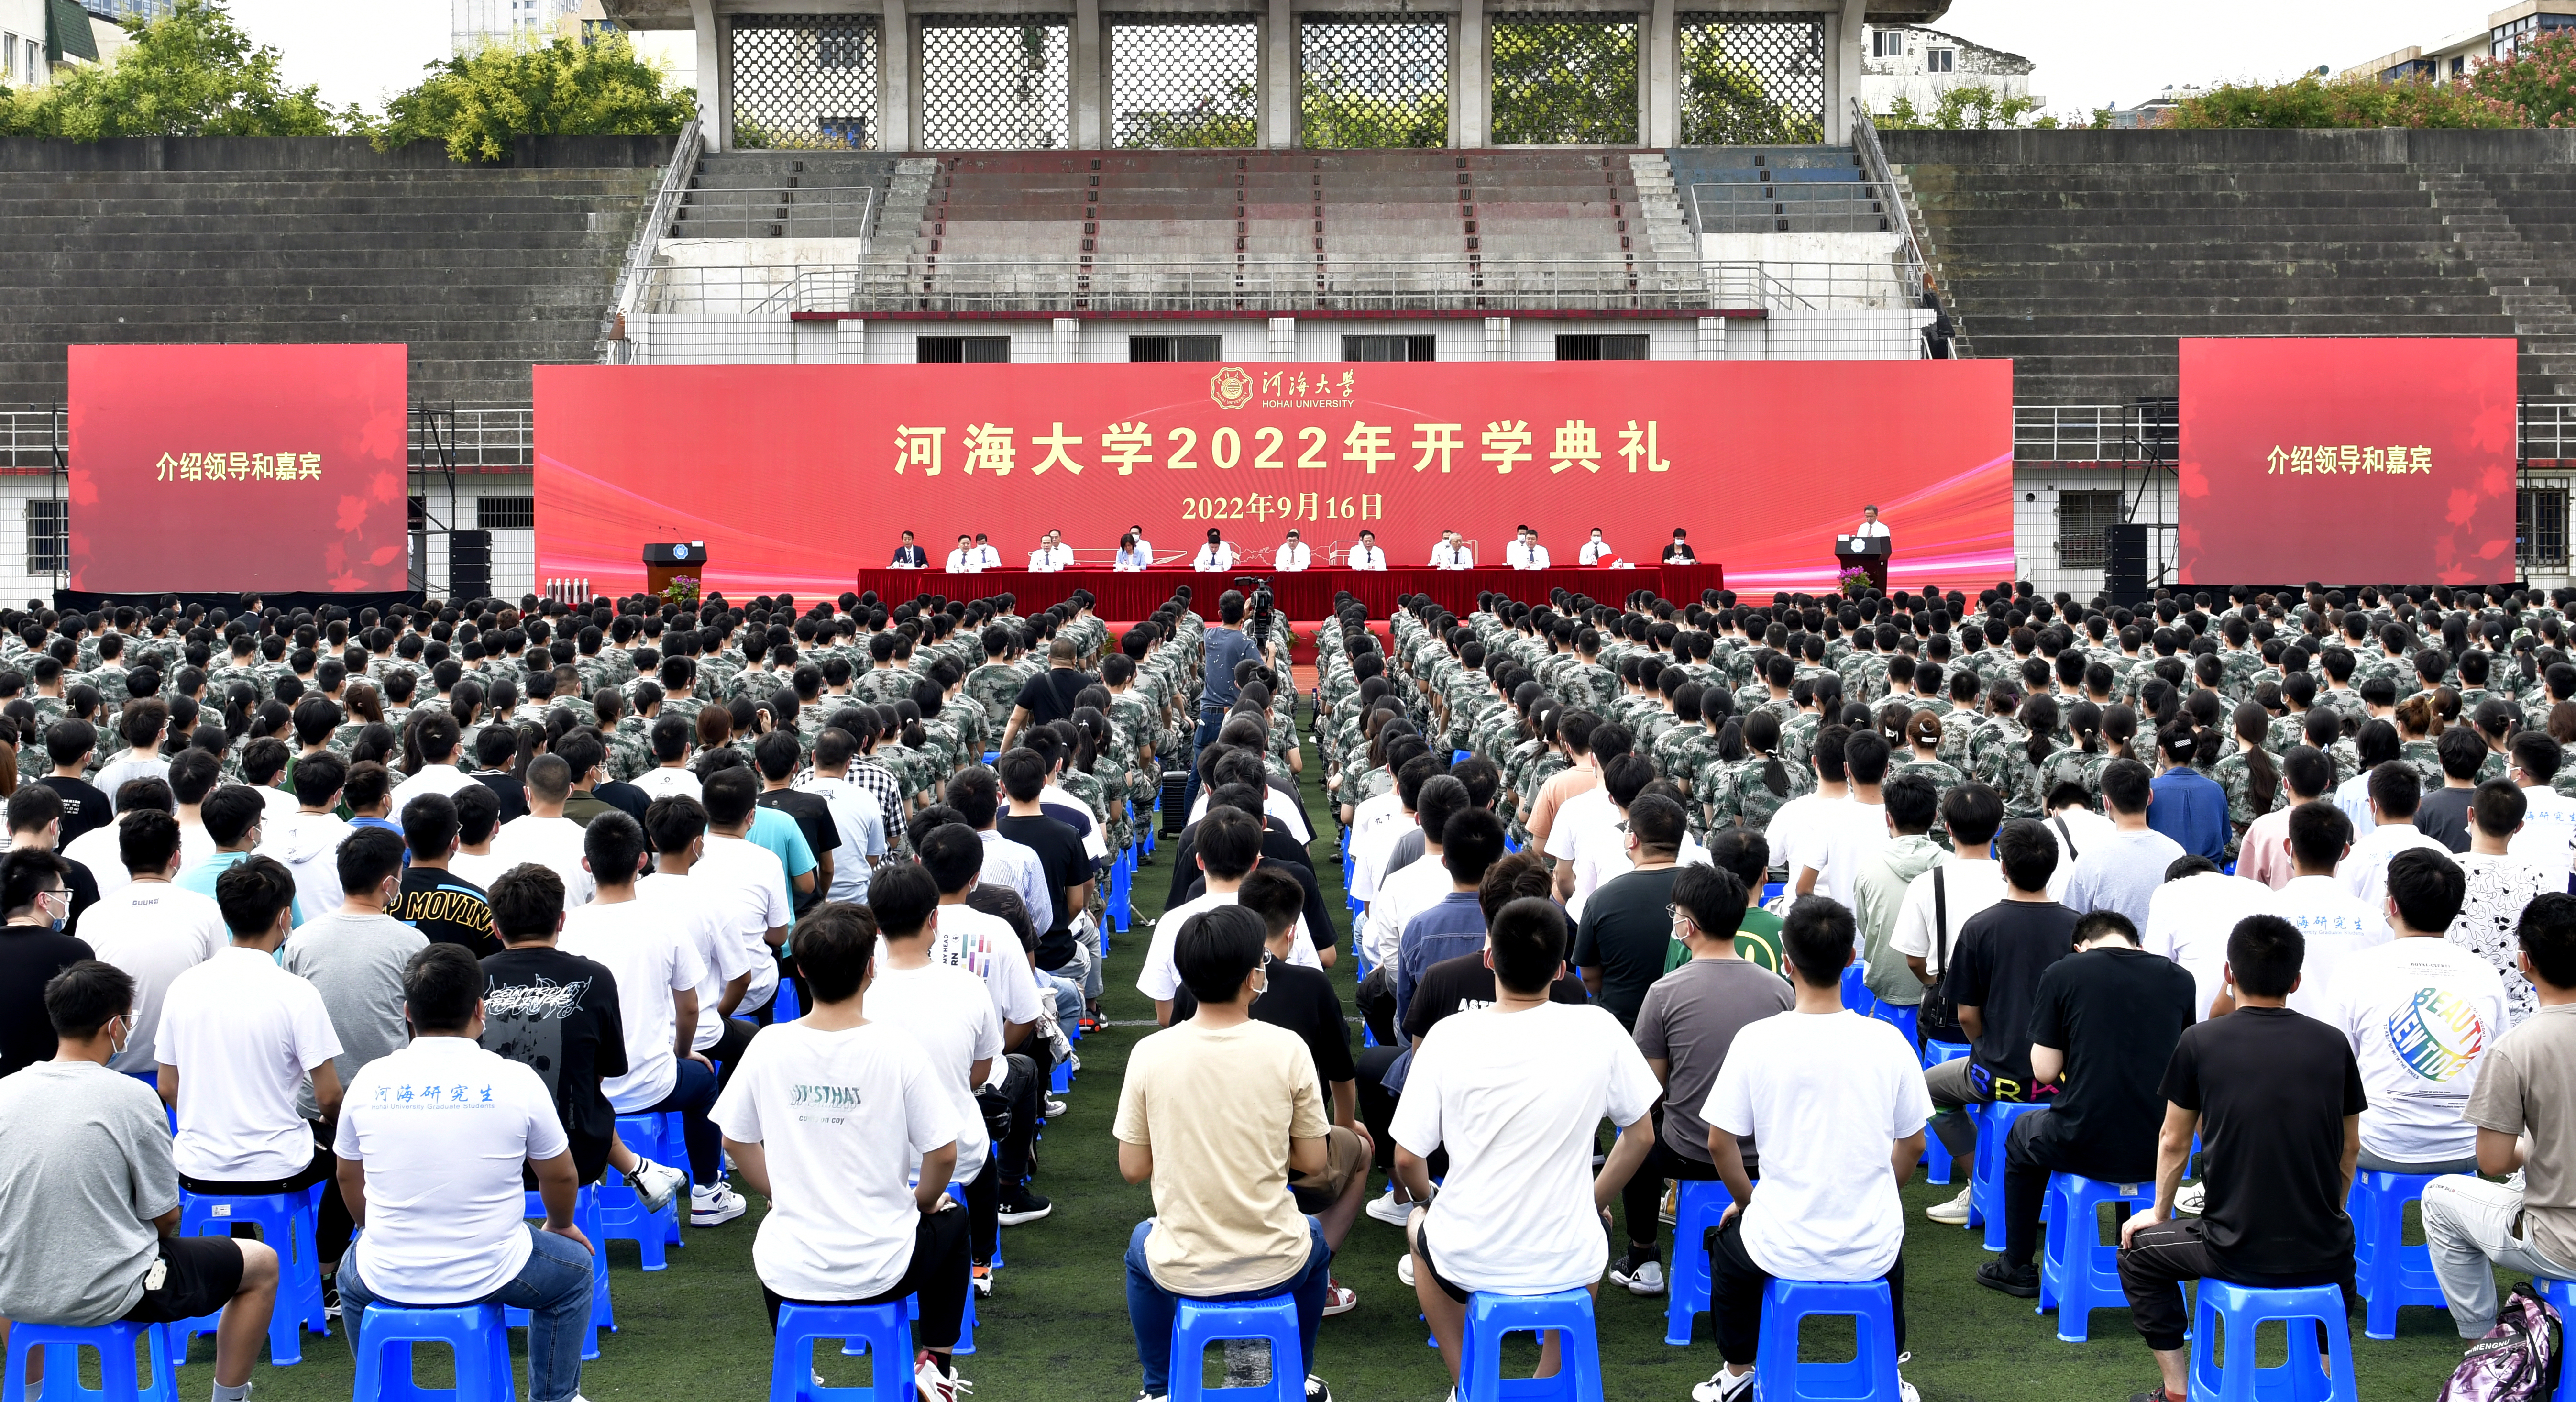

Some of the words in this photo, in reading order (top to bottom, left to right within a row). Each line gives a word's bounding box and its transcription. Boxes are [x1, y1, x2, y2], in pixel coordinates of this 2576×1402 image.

[1262, 368, 1354, 397] 河海大学
[1262, 400, 1292, 408] HOHAI
[1296, 400, 1354, 408] UNIVERSITY
[893, 421, 1671, 476] 河海大学2022年开学典礼
[2267, 444, 2432, 475] 介绍领导和嘉宾
[156, 451, 322, 482] 介绍领导和嘉宾
[1182, 492, 1382, 522] 2022年9月16日
[2525, 811, 2576, 821] 海研究生
[943, 954, 948, 964] MY
[1458, 998, 1497, 1011] AST
[2390, 993, 2429, 1054] NEW
[2411, 1040, 2472, 1081] TIDE
[2415, 988, 2482, 1058] BEAUTY
[2399, 1060, 2407, 1070] THE
[2406, 1069, 2420, 1080] TIMES
[375, 1083, 493, 1104] 河海研究生
